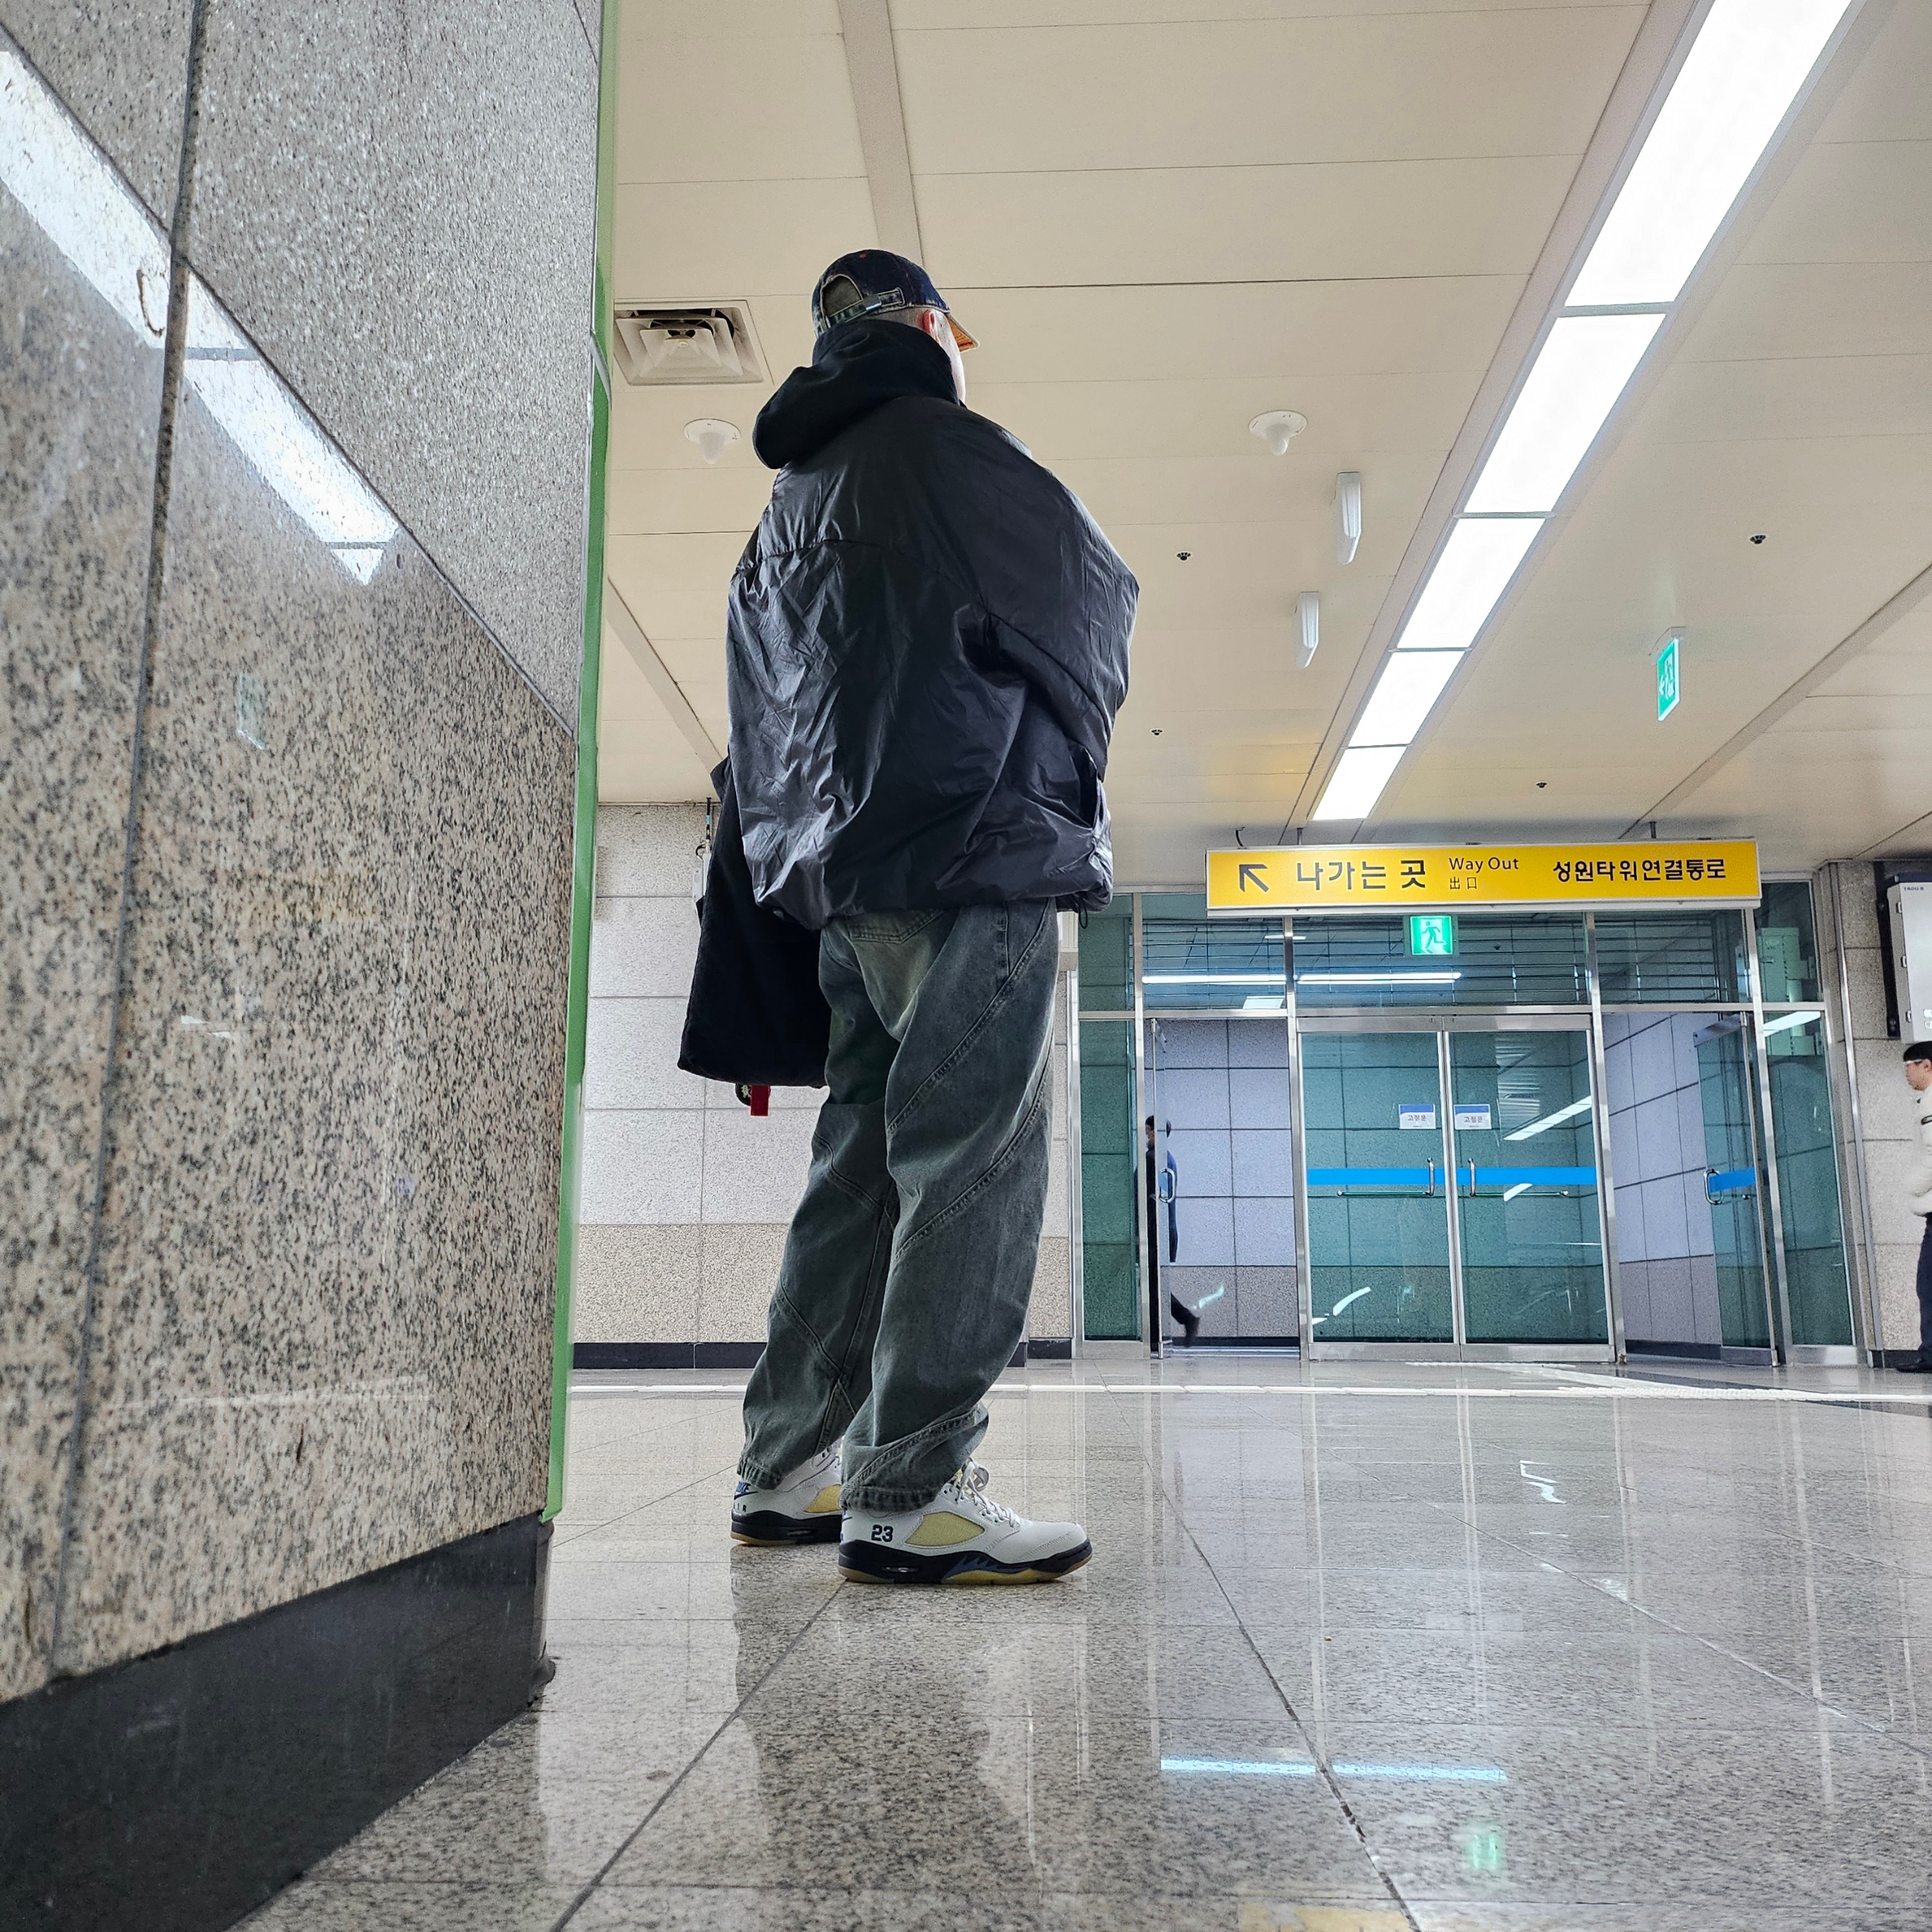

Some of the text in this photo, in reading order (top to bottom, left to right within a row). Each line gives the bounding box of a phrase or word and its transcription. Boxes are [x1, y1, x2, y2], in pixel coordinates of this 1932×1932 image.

[1449, 857, 1519, 873] Way Out
[1553, 858, 1726, 883] 성원타워연결통로
[1297, 860, 1426, 890] 나가는 곳
[1449, 876, 1477, 889] 出口
[871, 1524, 894, 1542] 23
